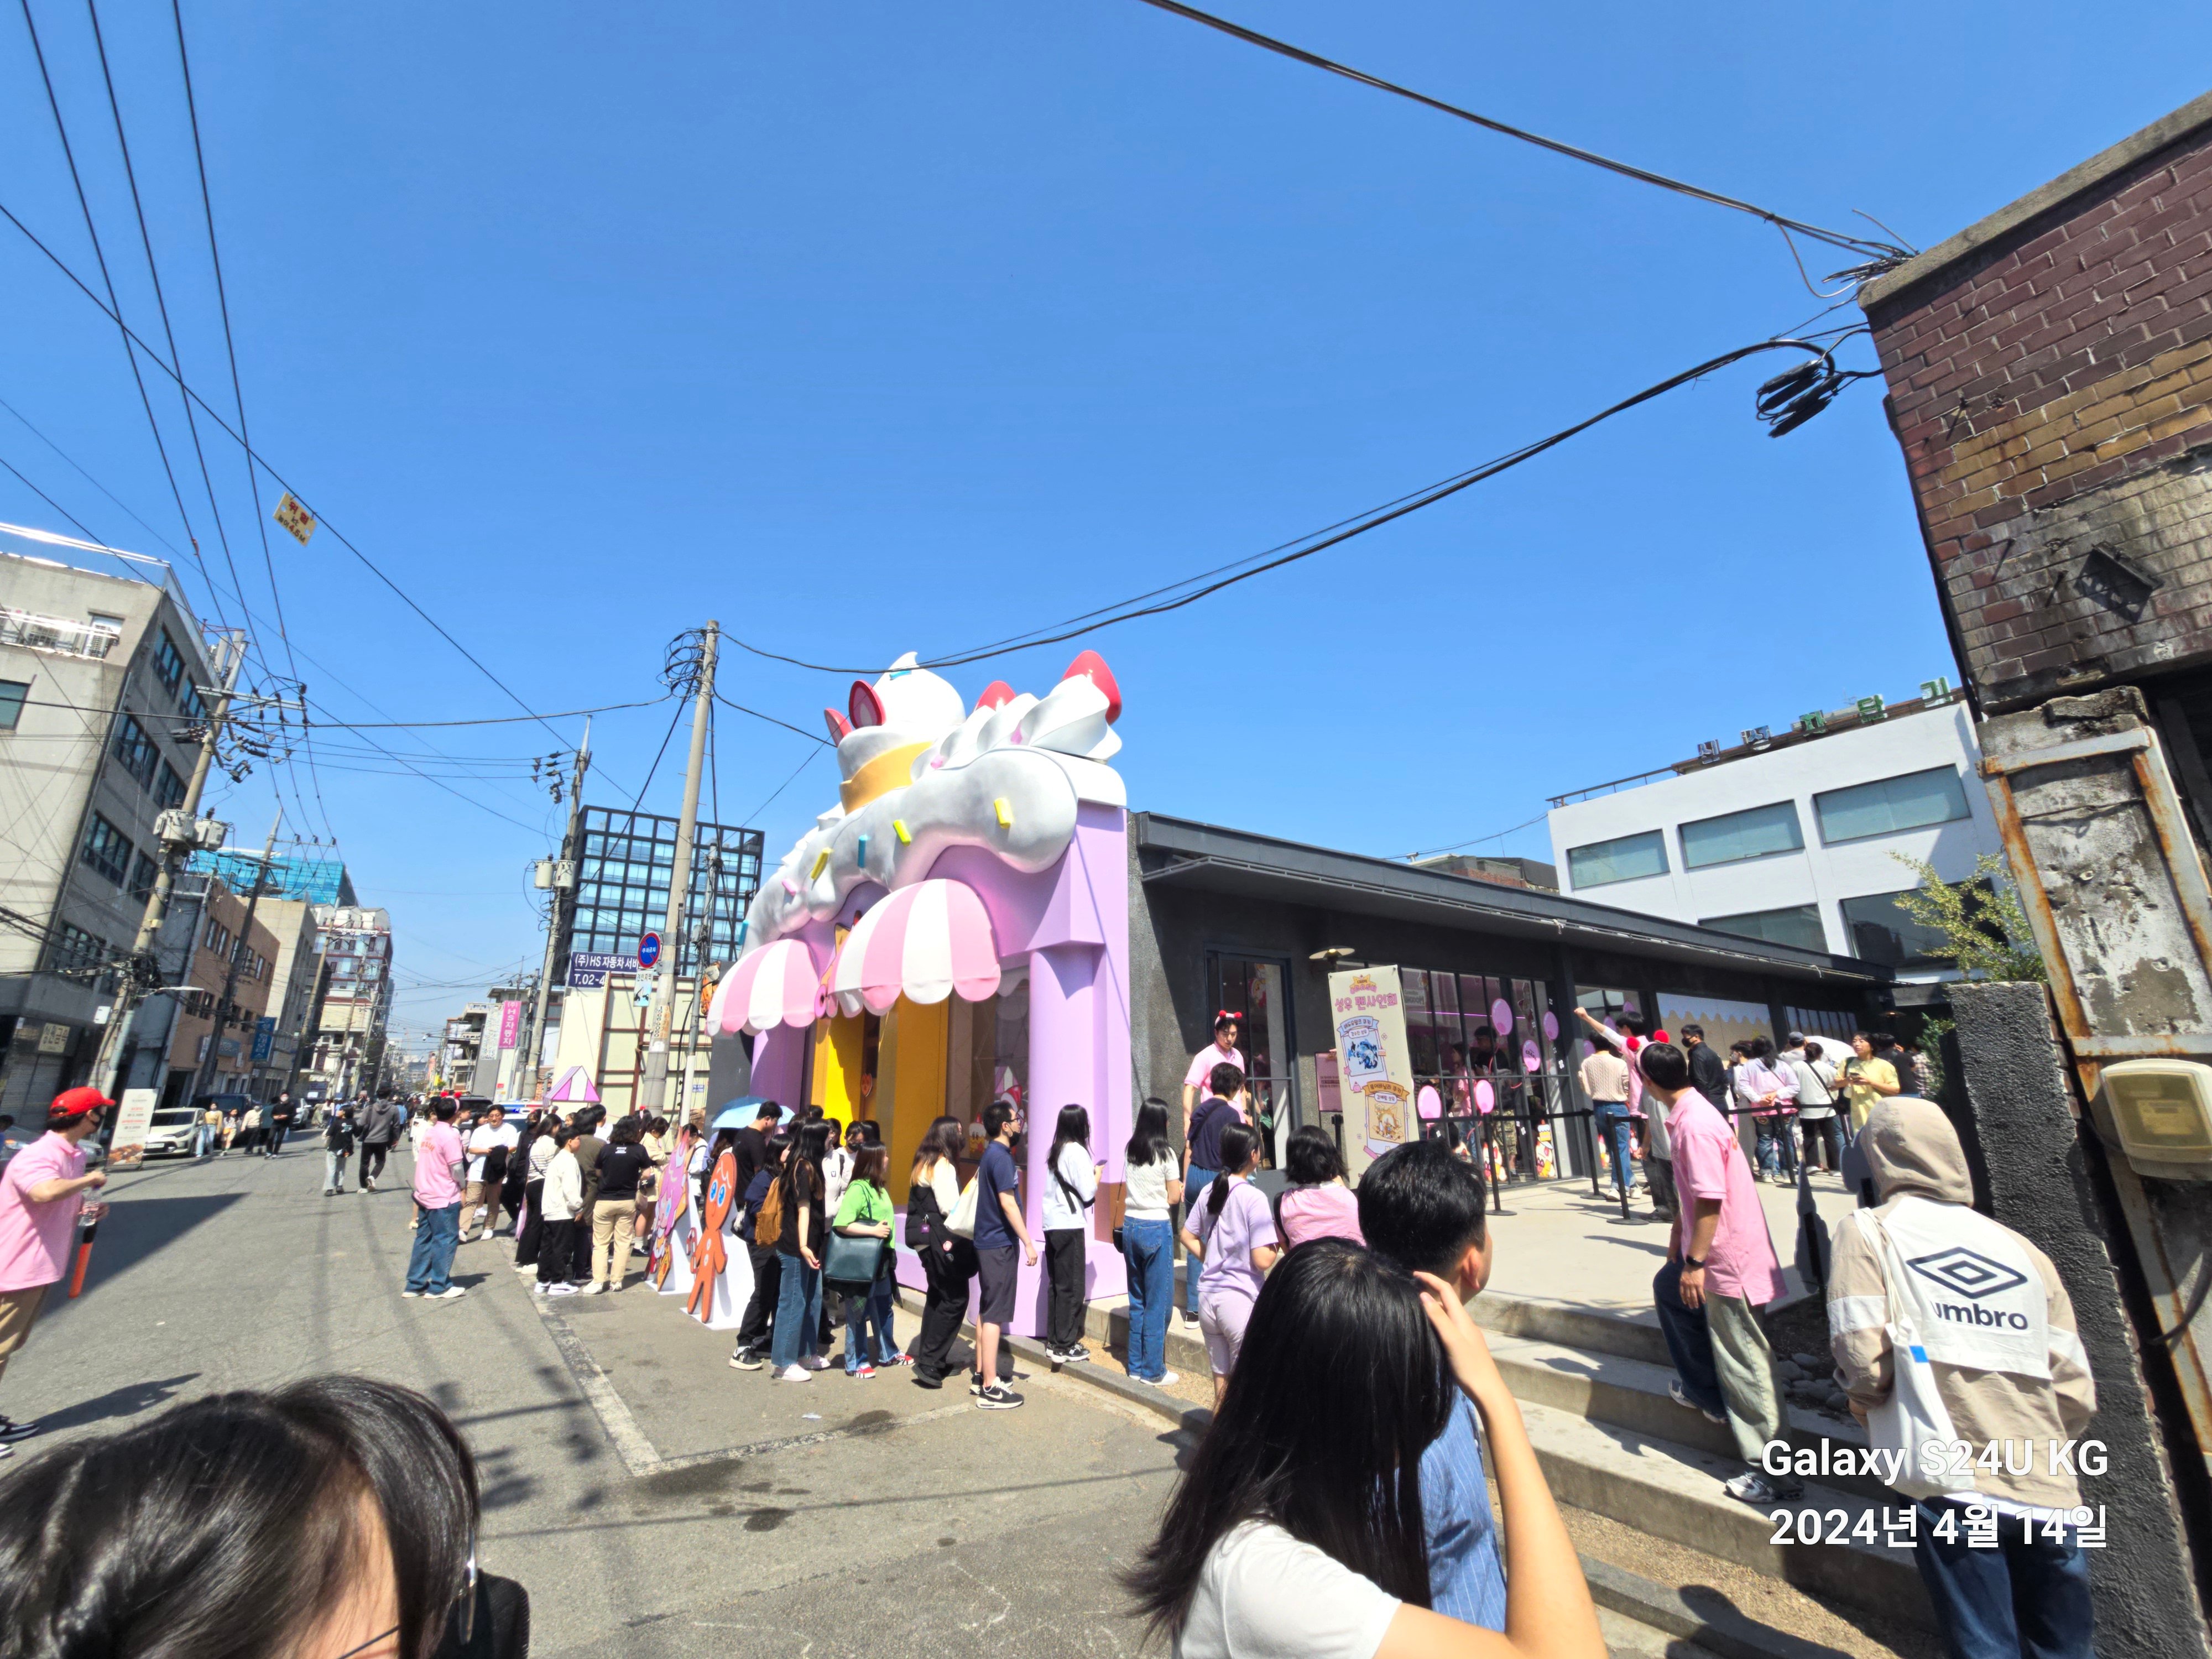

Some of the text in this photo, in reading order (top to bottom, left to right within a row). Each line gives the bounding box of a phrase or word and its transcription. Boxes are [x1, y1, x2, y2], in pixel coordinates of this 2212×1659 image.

[575, 953, 639, 969] (주) HS 자동차 서비
[574, 973, 606, 985] T.02-4
[1335, 997, 1353, 1013] 성우
[1354, 993, 1397, 1010] 팬사인회
[1930, 1301, 2028, 1330] umbro
